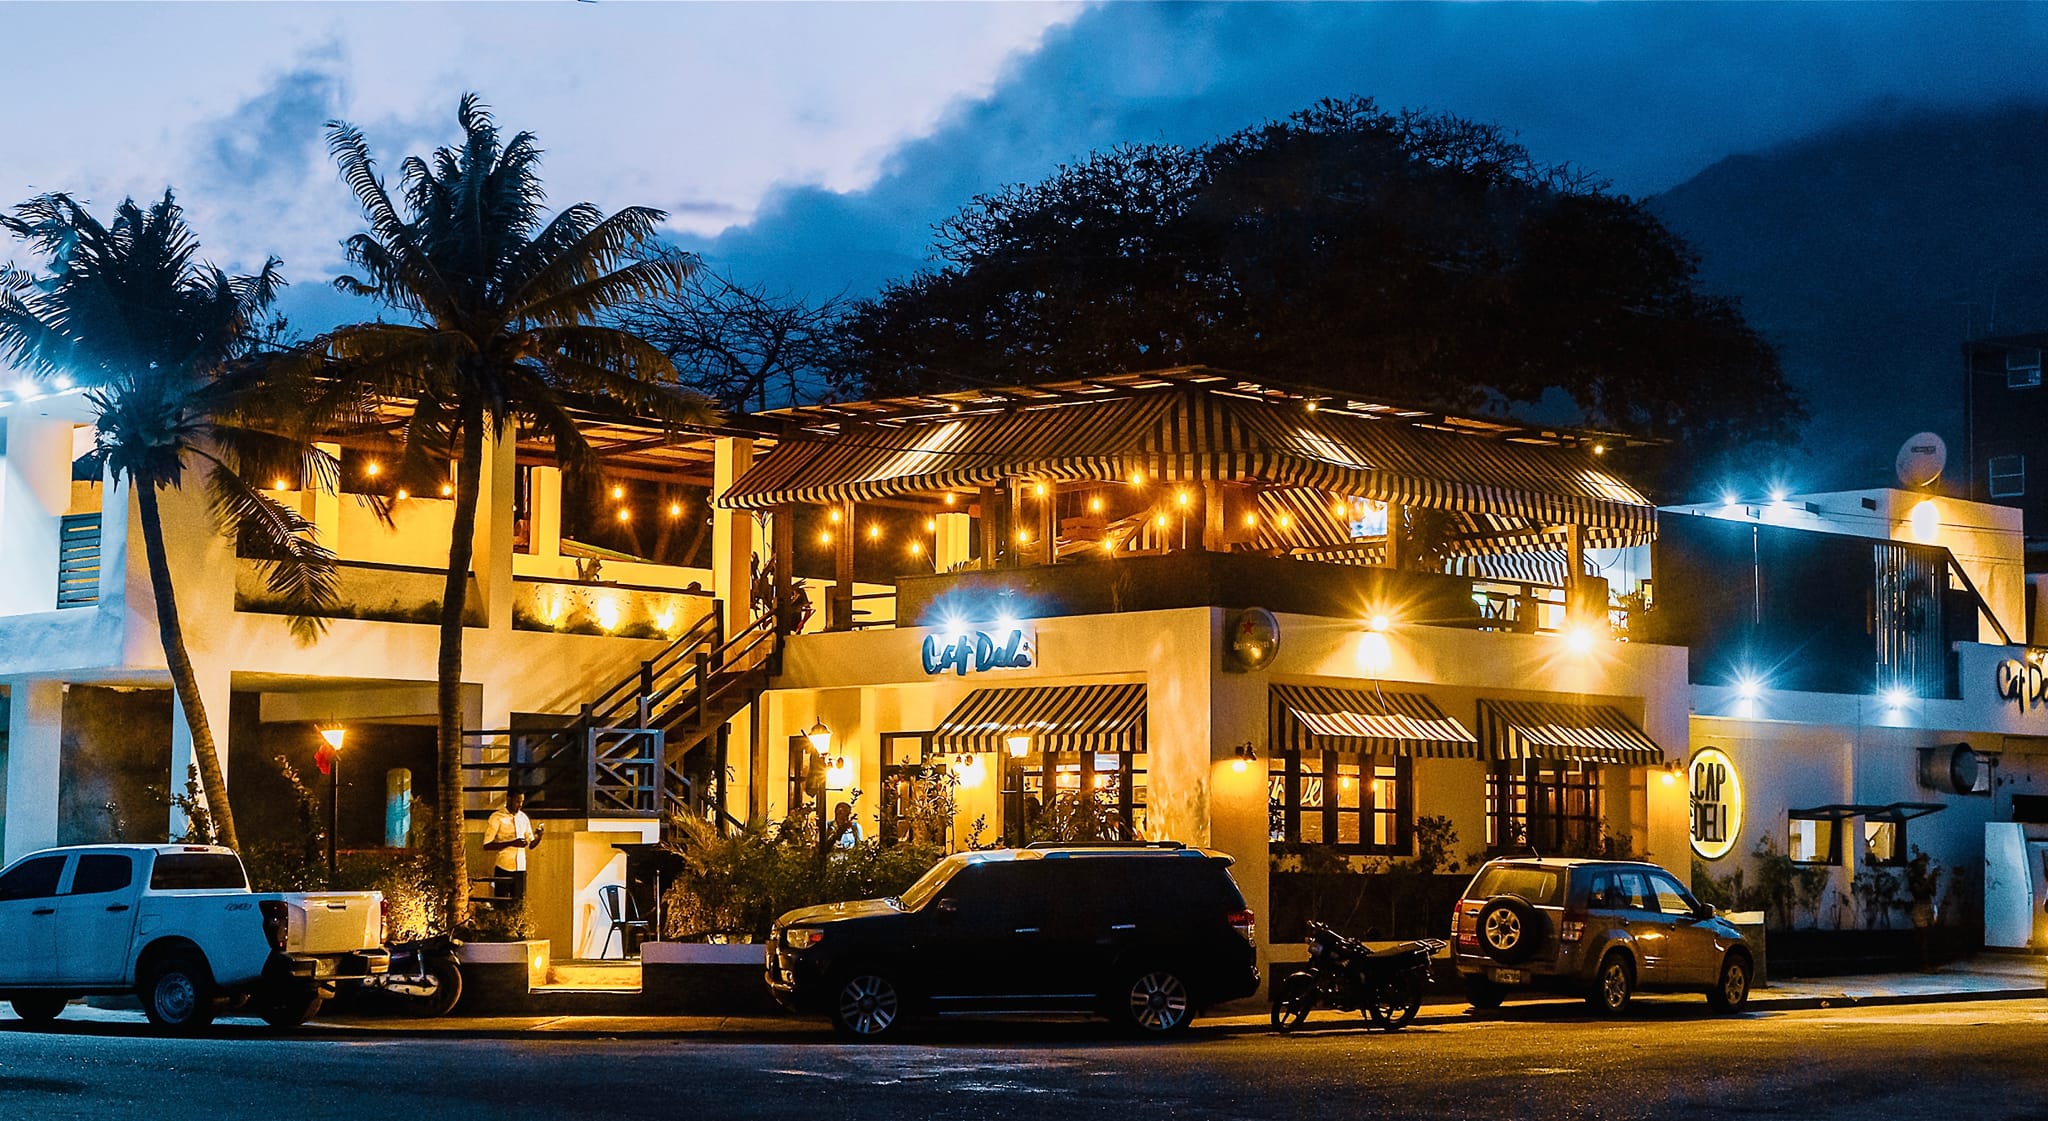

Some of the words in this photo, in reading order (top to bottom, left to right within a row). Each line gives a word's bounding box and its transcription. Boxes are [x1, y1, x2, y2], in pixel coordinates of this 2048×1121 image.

[975, 629, 1032, 673] Deli
[1997, 660, 2025, 714] Cap
[1694, 762, 1726, 802] CAP
[1693, 803, 1727, 843] DELI
